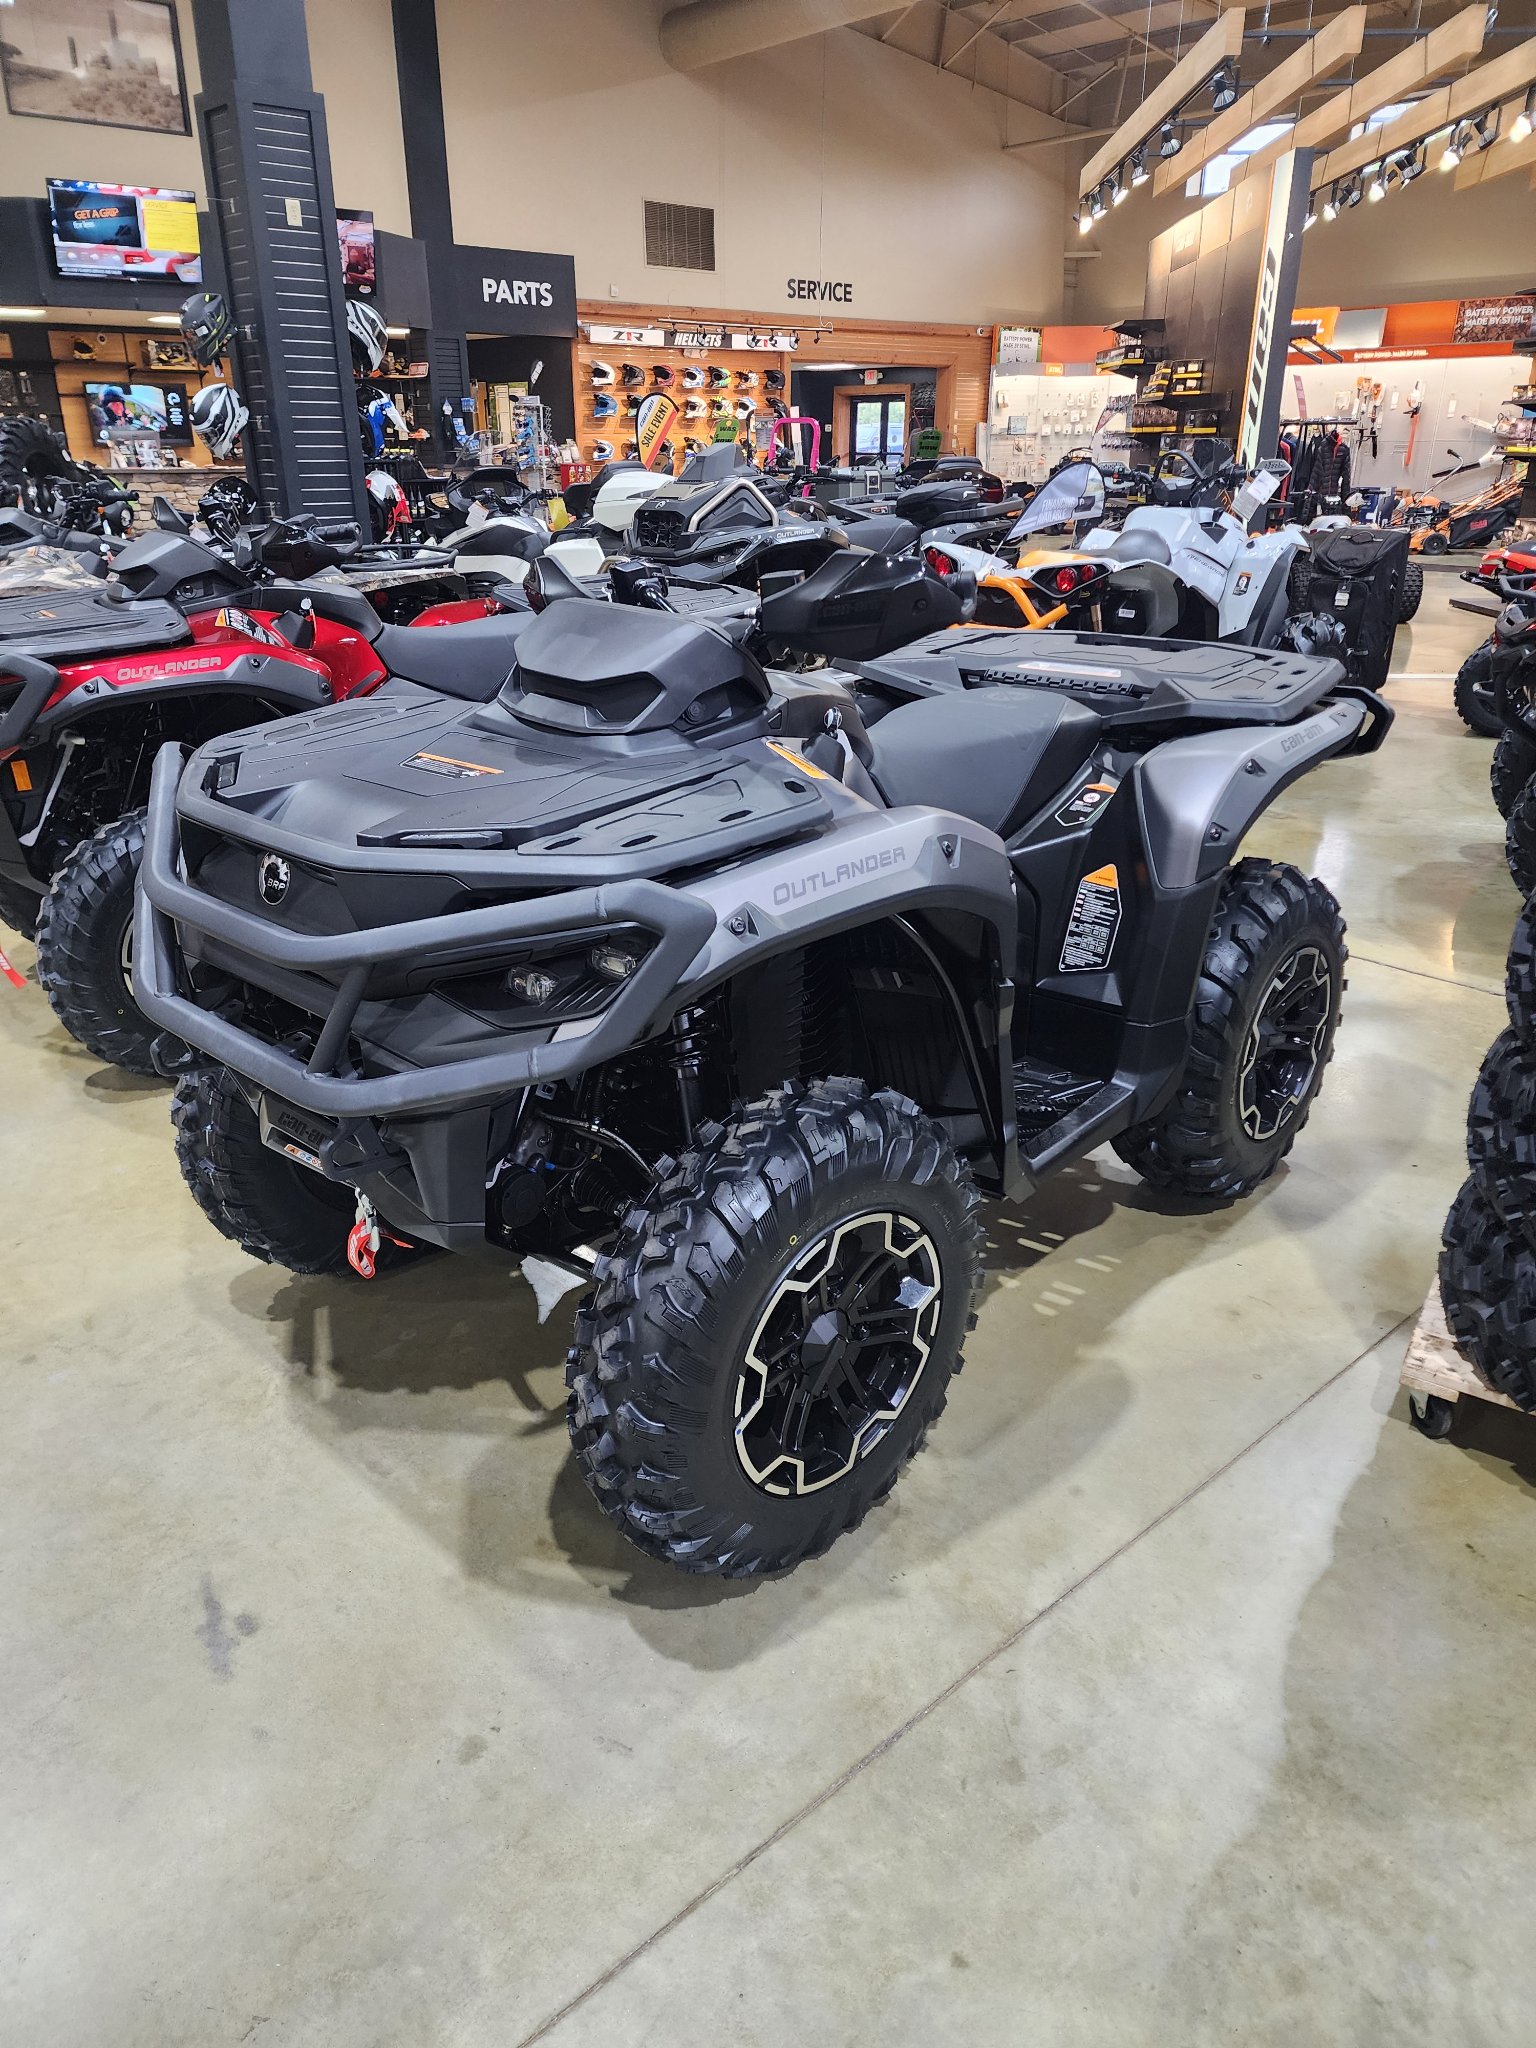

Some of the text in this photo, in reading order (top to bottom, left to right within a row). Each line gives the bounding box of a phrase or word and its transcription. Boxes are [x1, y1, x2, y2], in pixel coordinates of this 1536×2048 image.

[74, 207, 119, 220] GET A GRIP
[482, 277, 553, 307] PARTS
[787, 278, 853, 302] SERVICE
[1464, 317, 1488, 327] MADE
[1489, 317, 1501, 325] BY
[1465, 307, 1501, 317] BATTERY
[641, 402, 669, 448] SALE EVENT
[776, 528, 815, 539] OUTLANDER
[117, 656, 222, 681] OUTLANDER
[1281, 723, 1324, 753] can-am
[267, 877, 286, 891] BRP
[773, 846, 906, 906] OUTLANDER
